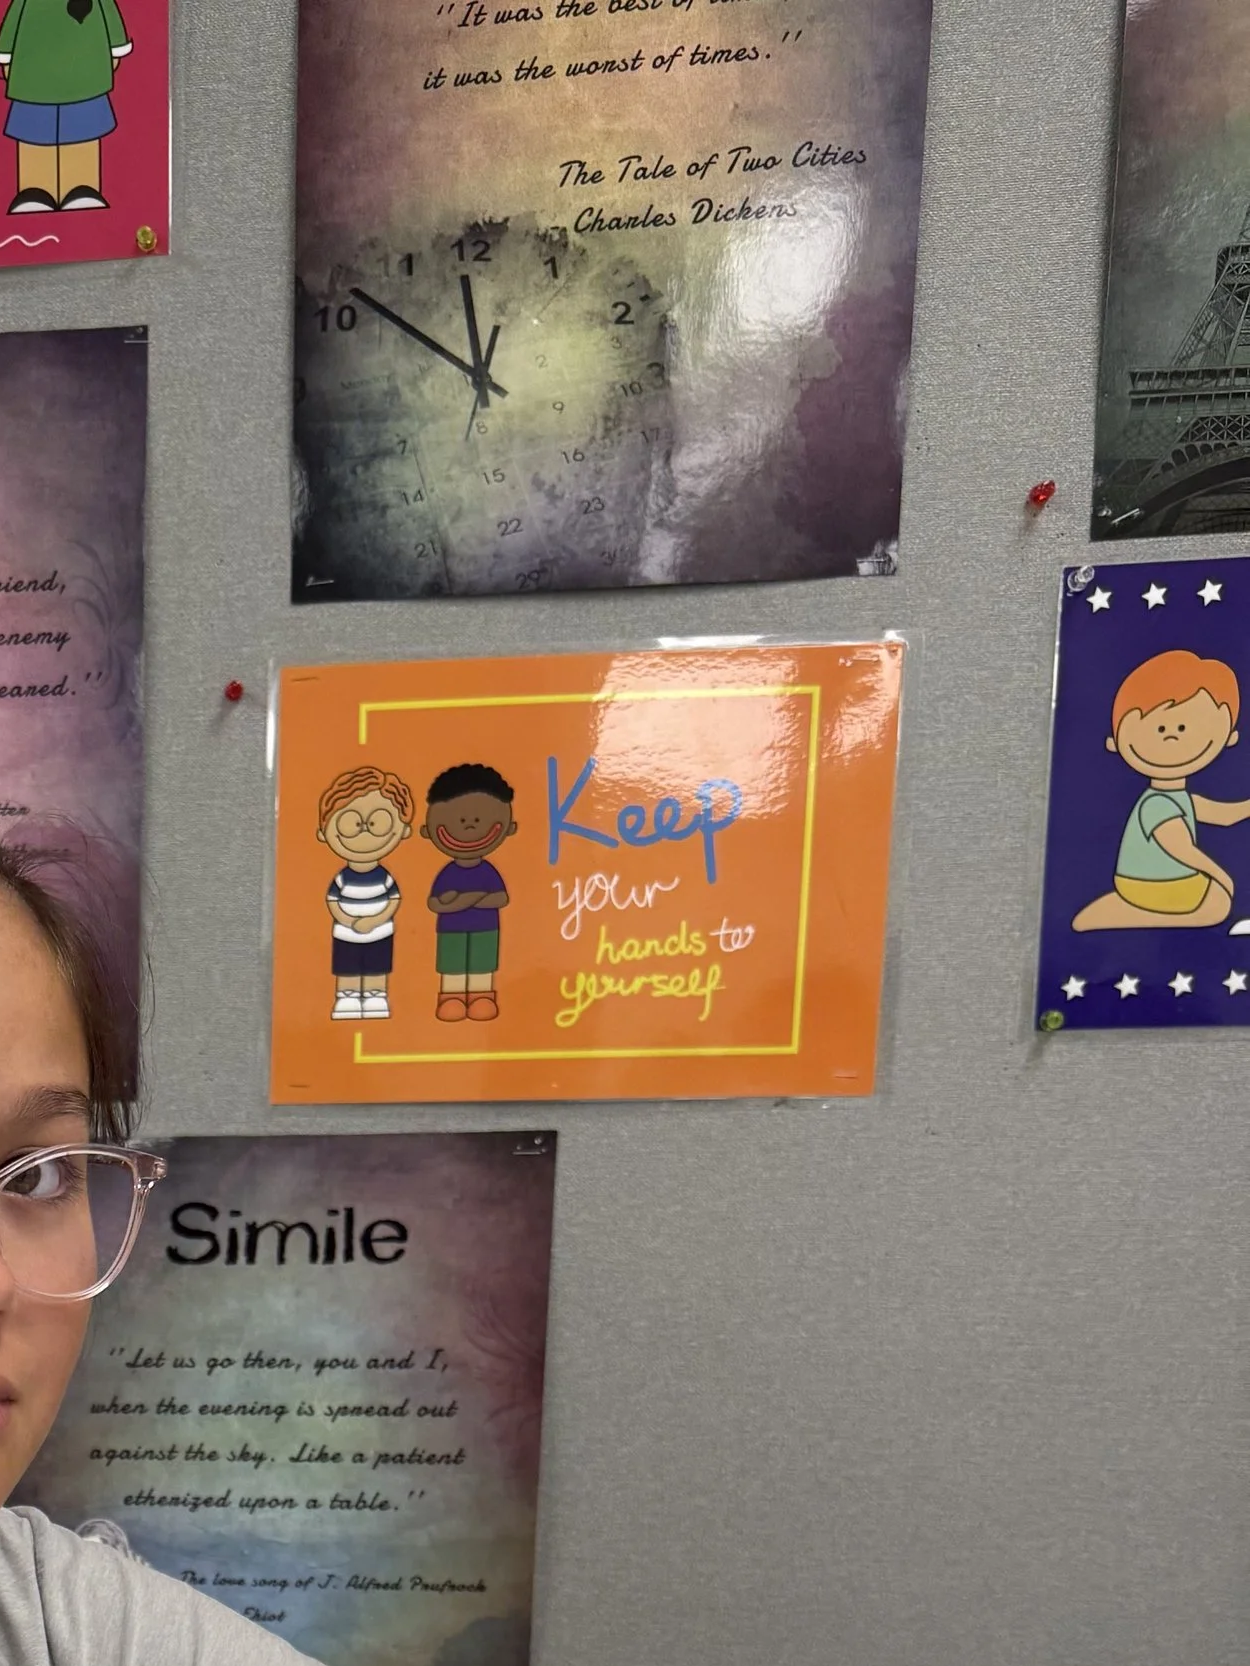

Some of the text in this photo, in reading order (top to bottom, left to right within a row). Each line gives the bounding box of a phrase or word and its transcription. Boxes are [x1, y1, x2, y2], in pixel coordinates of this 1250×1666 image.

[494, 7, 544, 24] was
[554, 0, 598, 19] the
[454, 67, 502, 88] was
[514, 56, 555, 82] the
[565, 49, 646, 78] worst
[652, 46, 684, 73] of
[558, 140, 867, 190] The Tale of Two Cities
[573, 196, 799, 235] Charles Dickens
[450, 239, 493, 263] 12
[314, 305, 358, 332] 10
[611, 301, 634, 325] 2
[497, 518, 524, 537] 22
[547, 756, 743, 884] Keep
[552, 872, 681, 941] your
[597, 918, 756, 965] hands to
[555, 964, 726, 1028] yourself
[165, 1200, 410, 1267] Simile
[206, 1353, 238, 1377] go
[243, 1349, 302, 1374] then,
[313, 1354, 358, 1377] you
[365, 1349, 415, 1371] and
[89, 1396, 459, 1425] when the evening spread out
[89, 1442, 467, 1472] against the sky. Like patient
[123, 1489, 233, 1514] etherized
[238, 1494, 299, 1515] upon
[212, 1571, 248, 1588] love
[251, 1574, 289, 1592] song
[346, 1574, 403, 1592] Alfred
[409, 1574, 488, 1594] Prufrock
